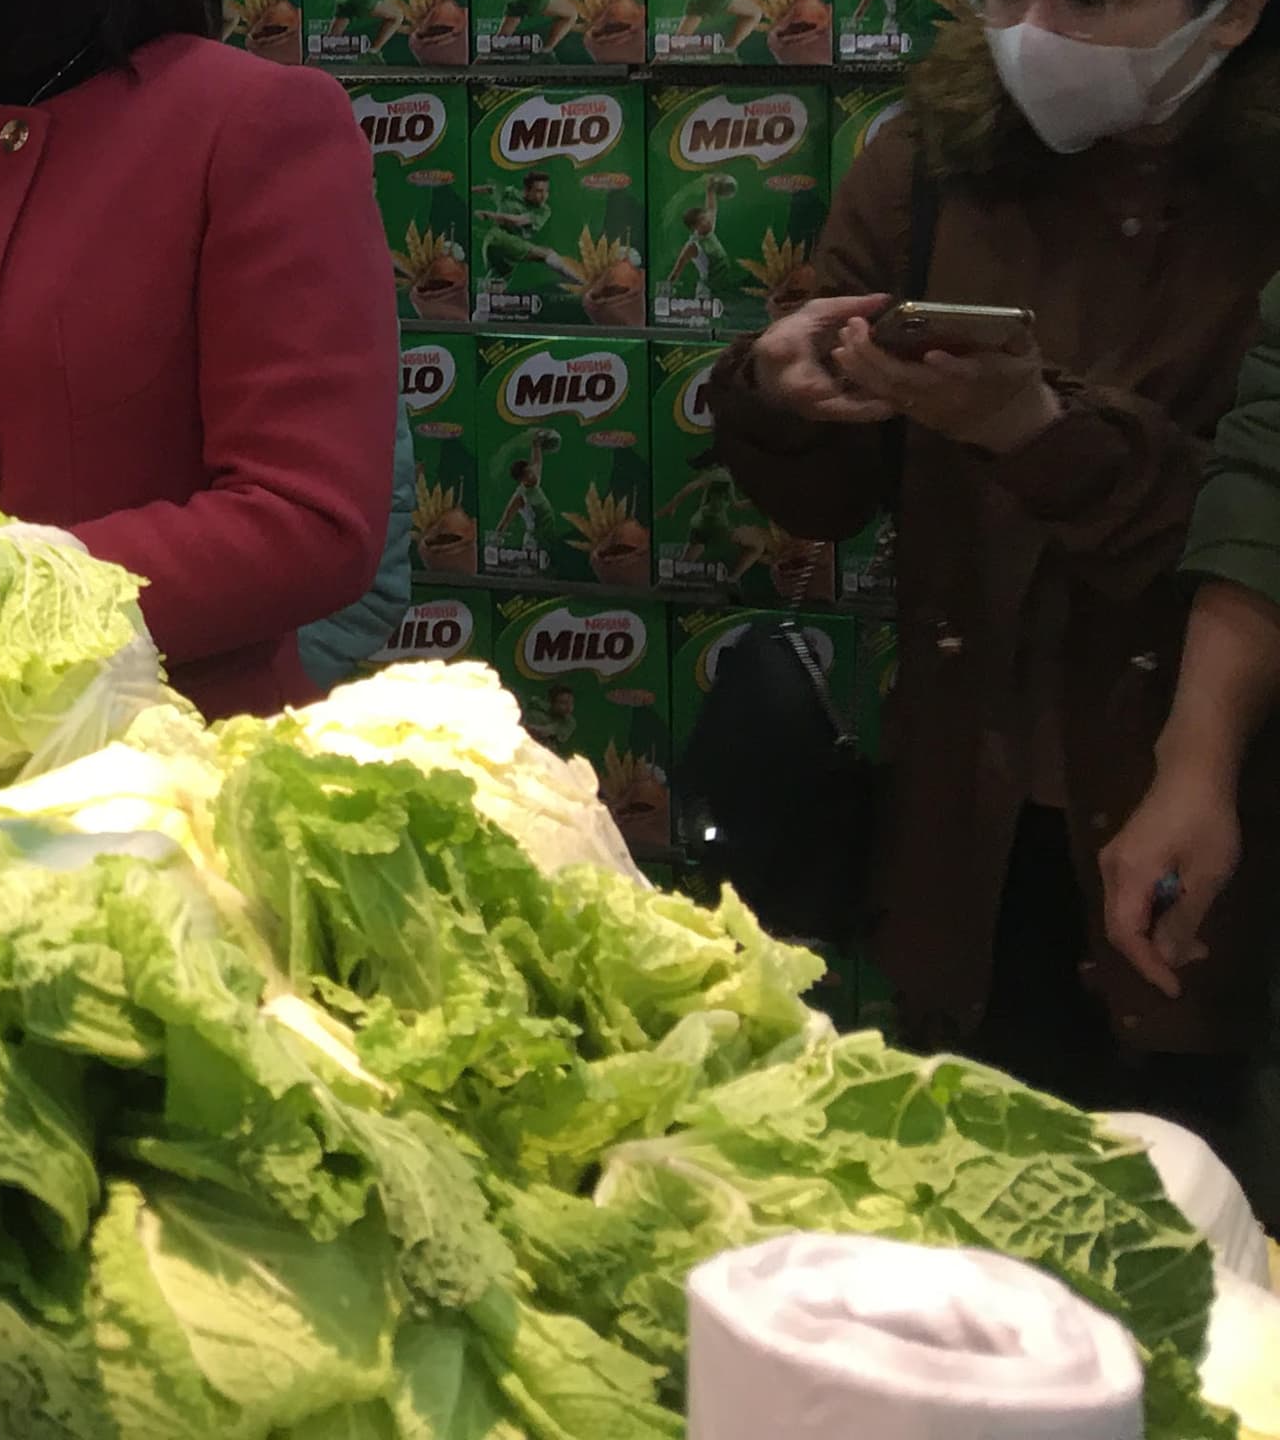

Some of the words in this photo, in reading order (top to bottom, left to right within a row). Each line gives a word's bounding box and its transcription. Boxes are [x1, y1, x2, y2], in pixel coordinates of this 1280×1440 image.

[508, 114, 611, 152] MILO
[689, 115, 796, 152] MILO
[514, 370, 616, 407] MILO
[534, 627, 635, 661] MILO
